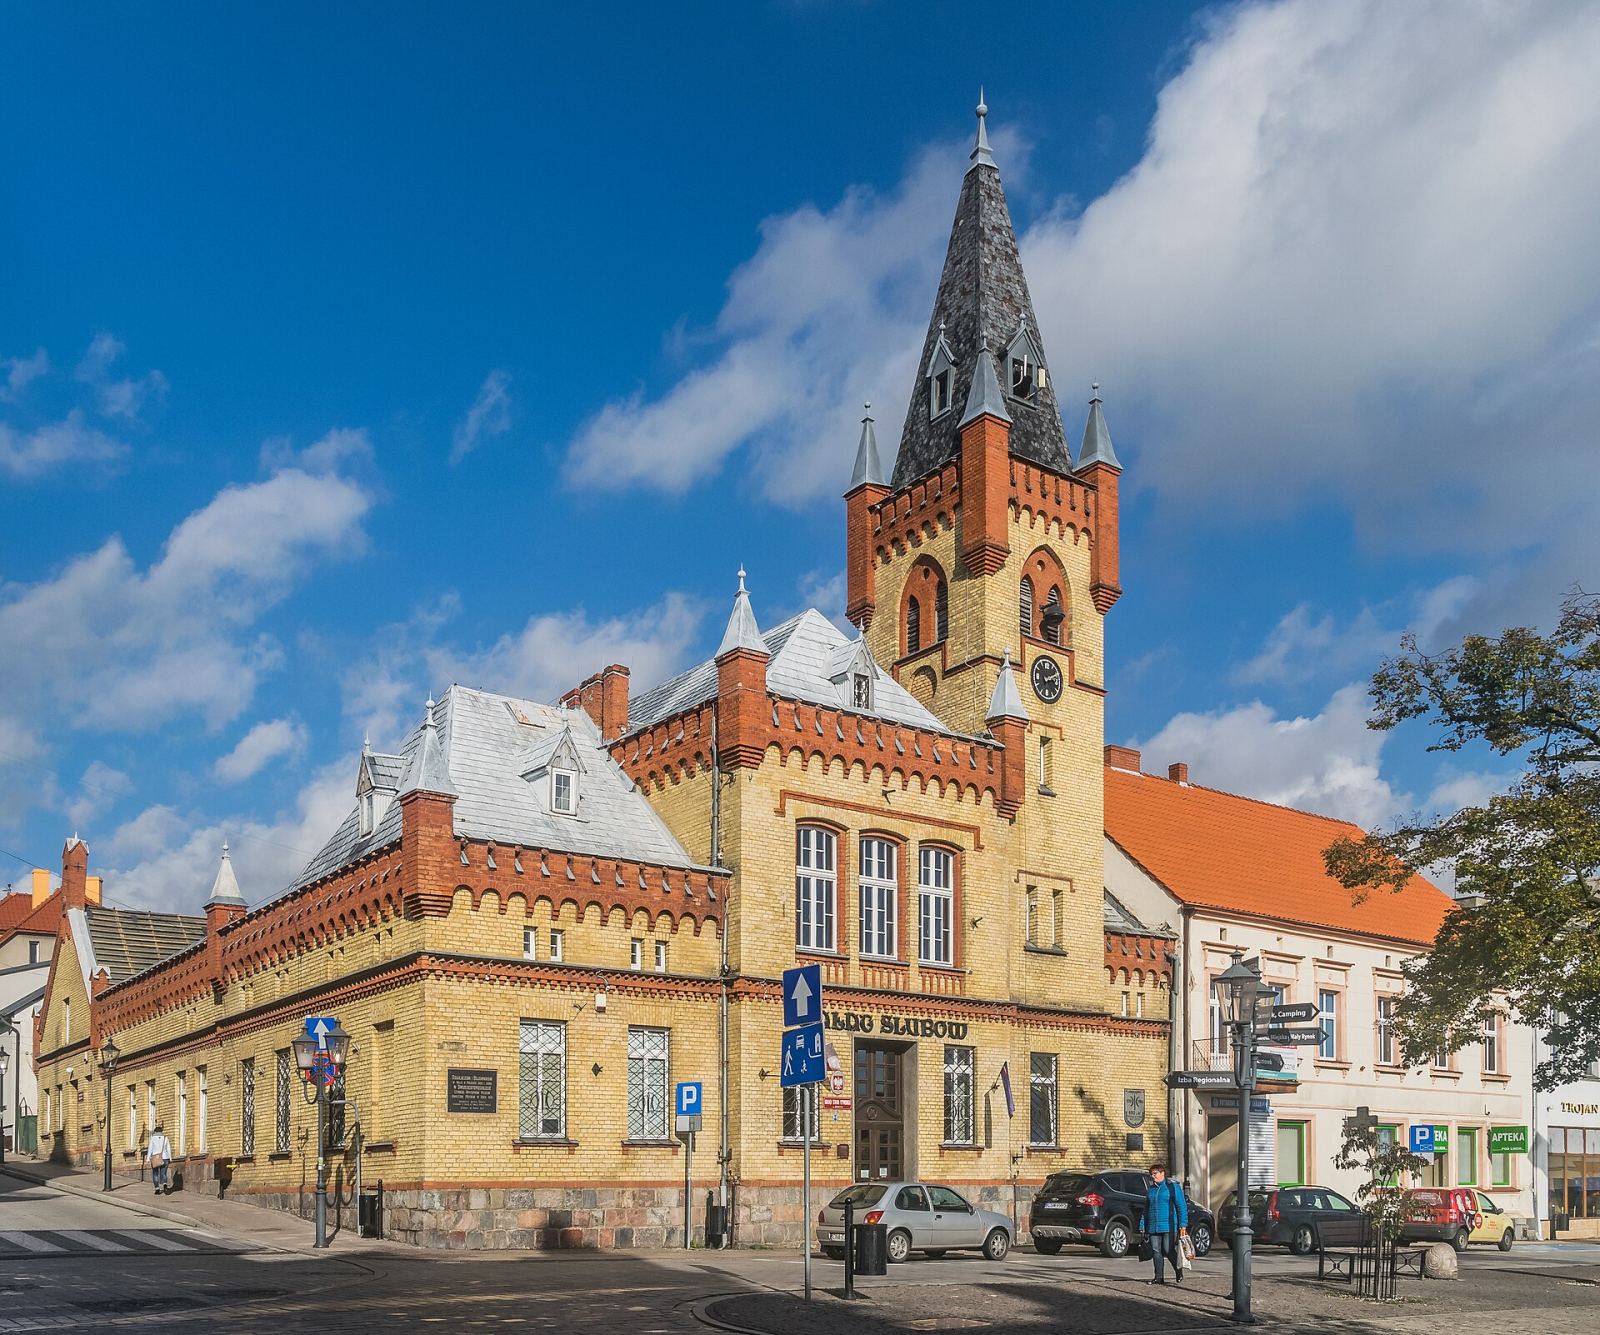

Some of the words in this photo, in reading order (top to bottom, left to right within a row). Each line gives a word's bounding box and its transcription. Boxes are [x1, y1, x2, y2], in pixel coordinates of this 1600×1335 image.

[1277, 1009, 1306, 1018] Camping
[1301, 1033, 1316, 1041] Rynek
[1192, 1076, 1231, 1085] Regionalna
[682, 1086, 697, 1112] P
[1560, 1102, 1599, 1116] TROJAN
[1415, 1127, 1430, 1145] P
[1491, 1132, 1525, 1142] APTEKA
